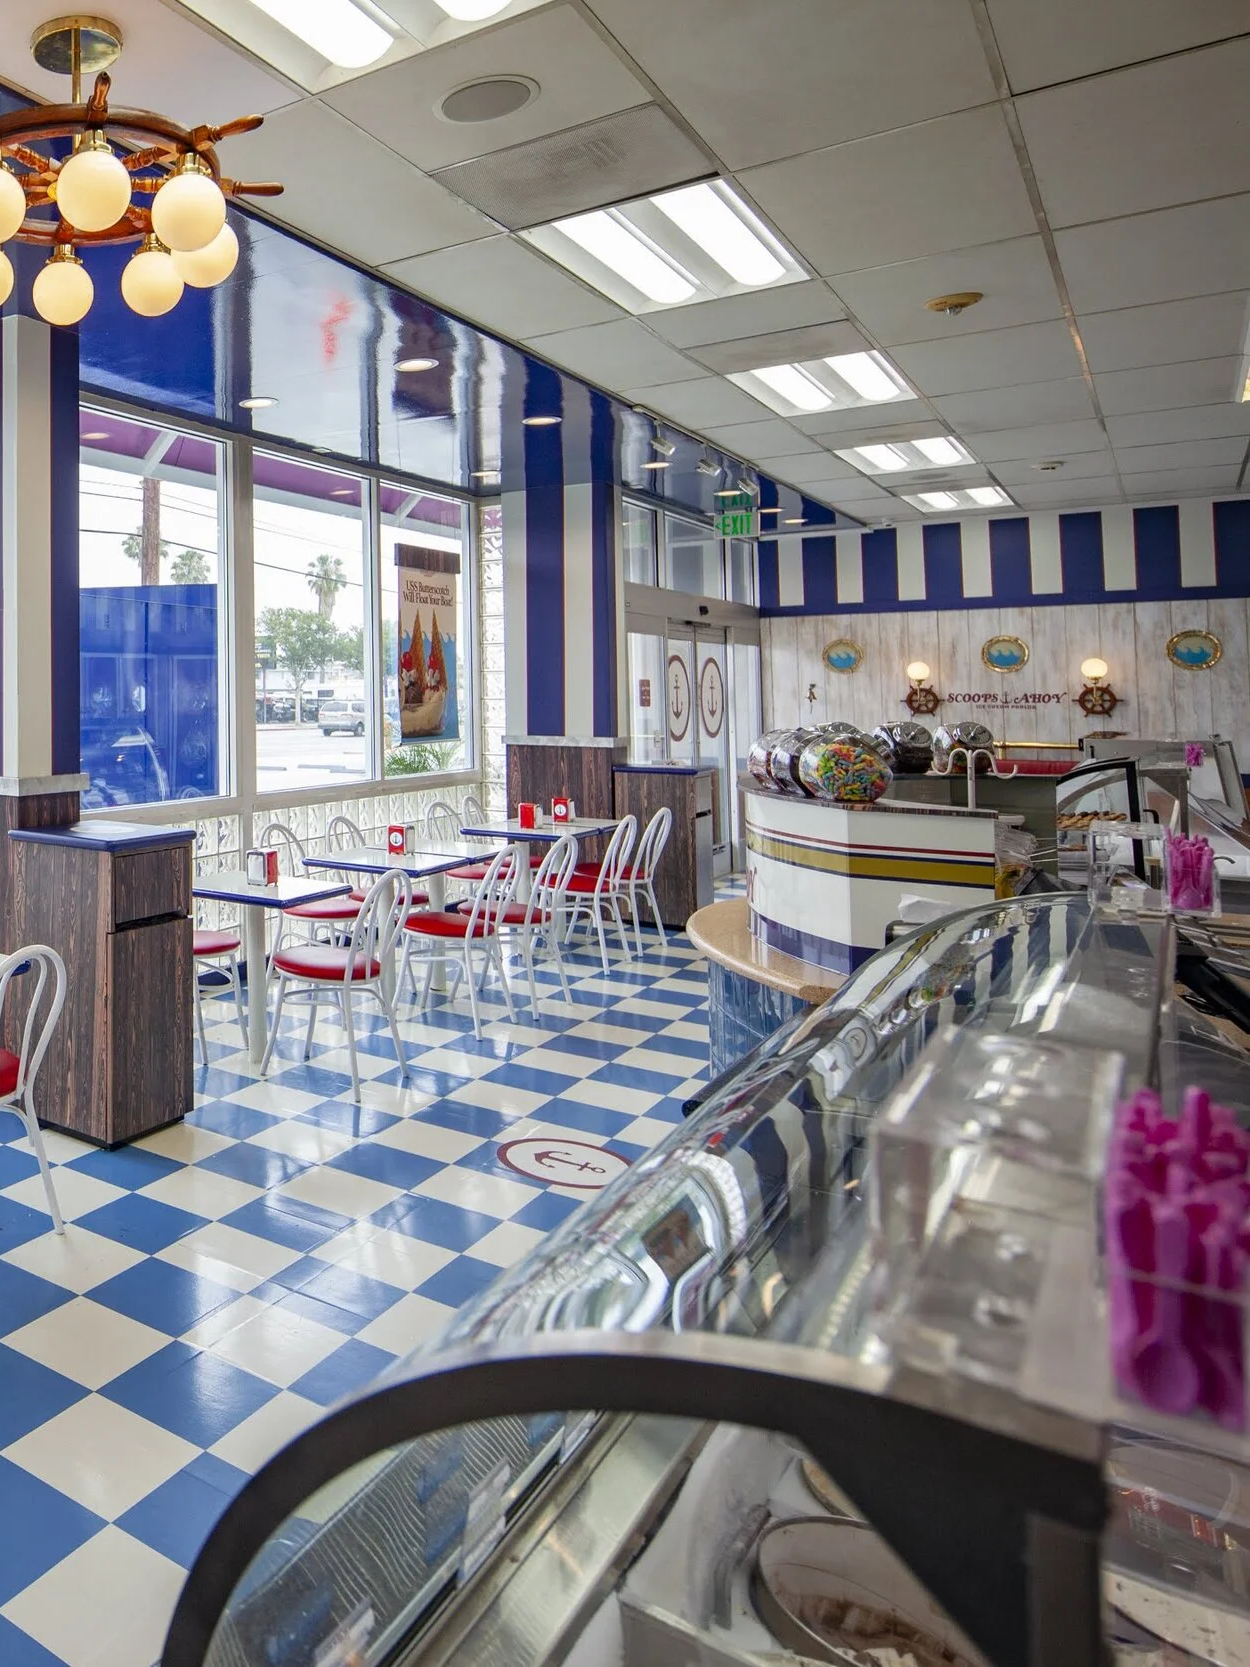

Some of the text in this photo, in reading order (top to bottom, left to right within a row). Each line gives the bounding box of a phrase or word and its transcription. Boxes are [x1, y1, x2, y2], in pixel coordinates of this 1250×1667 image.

[722, 513, 752, 536] EXIT
[406, 580, 449, 595] USS Butterscotch
[403, 591, 453, 607] Will Float Your Boat!
[946, 692, 1067, 704] SCOOPS AHOY
